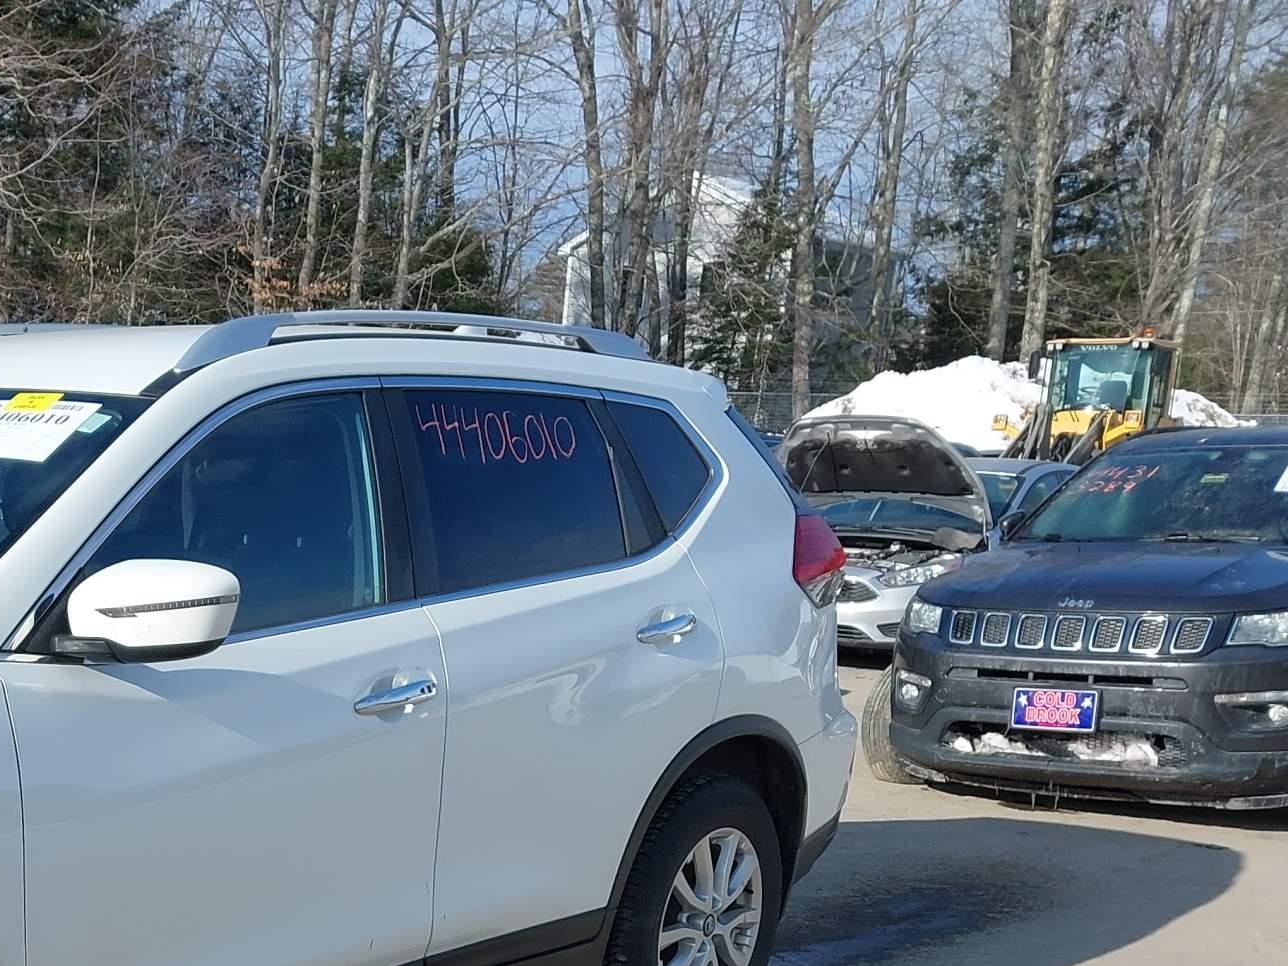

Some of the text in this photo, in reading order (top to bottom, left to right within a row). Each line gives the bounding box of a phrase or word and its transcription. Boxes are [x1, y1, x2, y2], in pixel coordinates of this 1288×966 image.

[416, 403, 576, 464] 44406010
[1058, 597, 1094, 609] Jeep
[1033, 691, 1077, 707] COLD
[1025, 706, 1081, 724] BROOK
